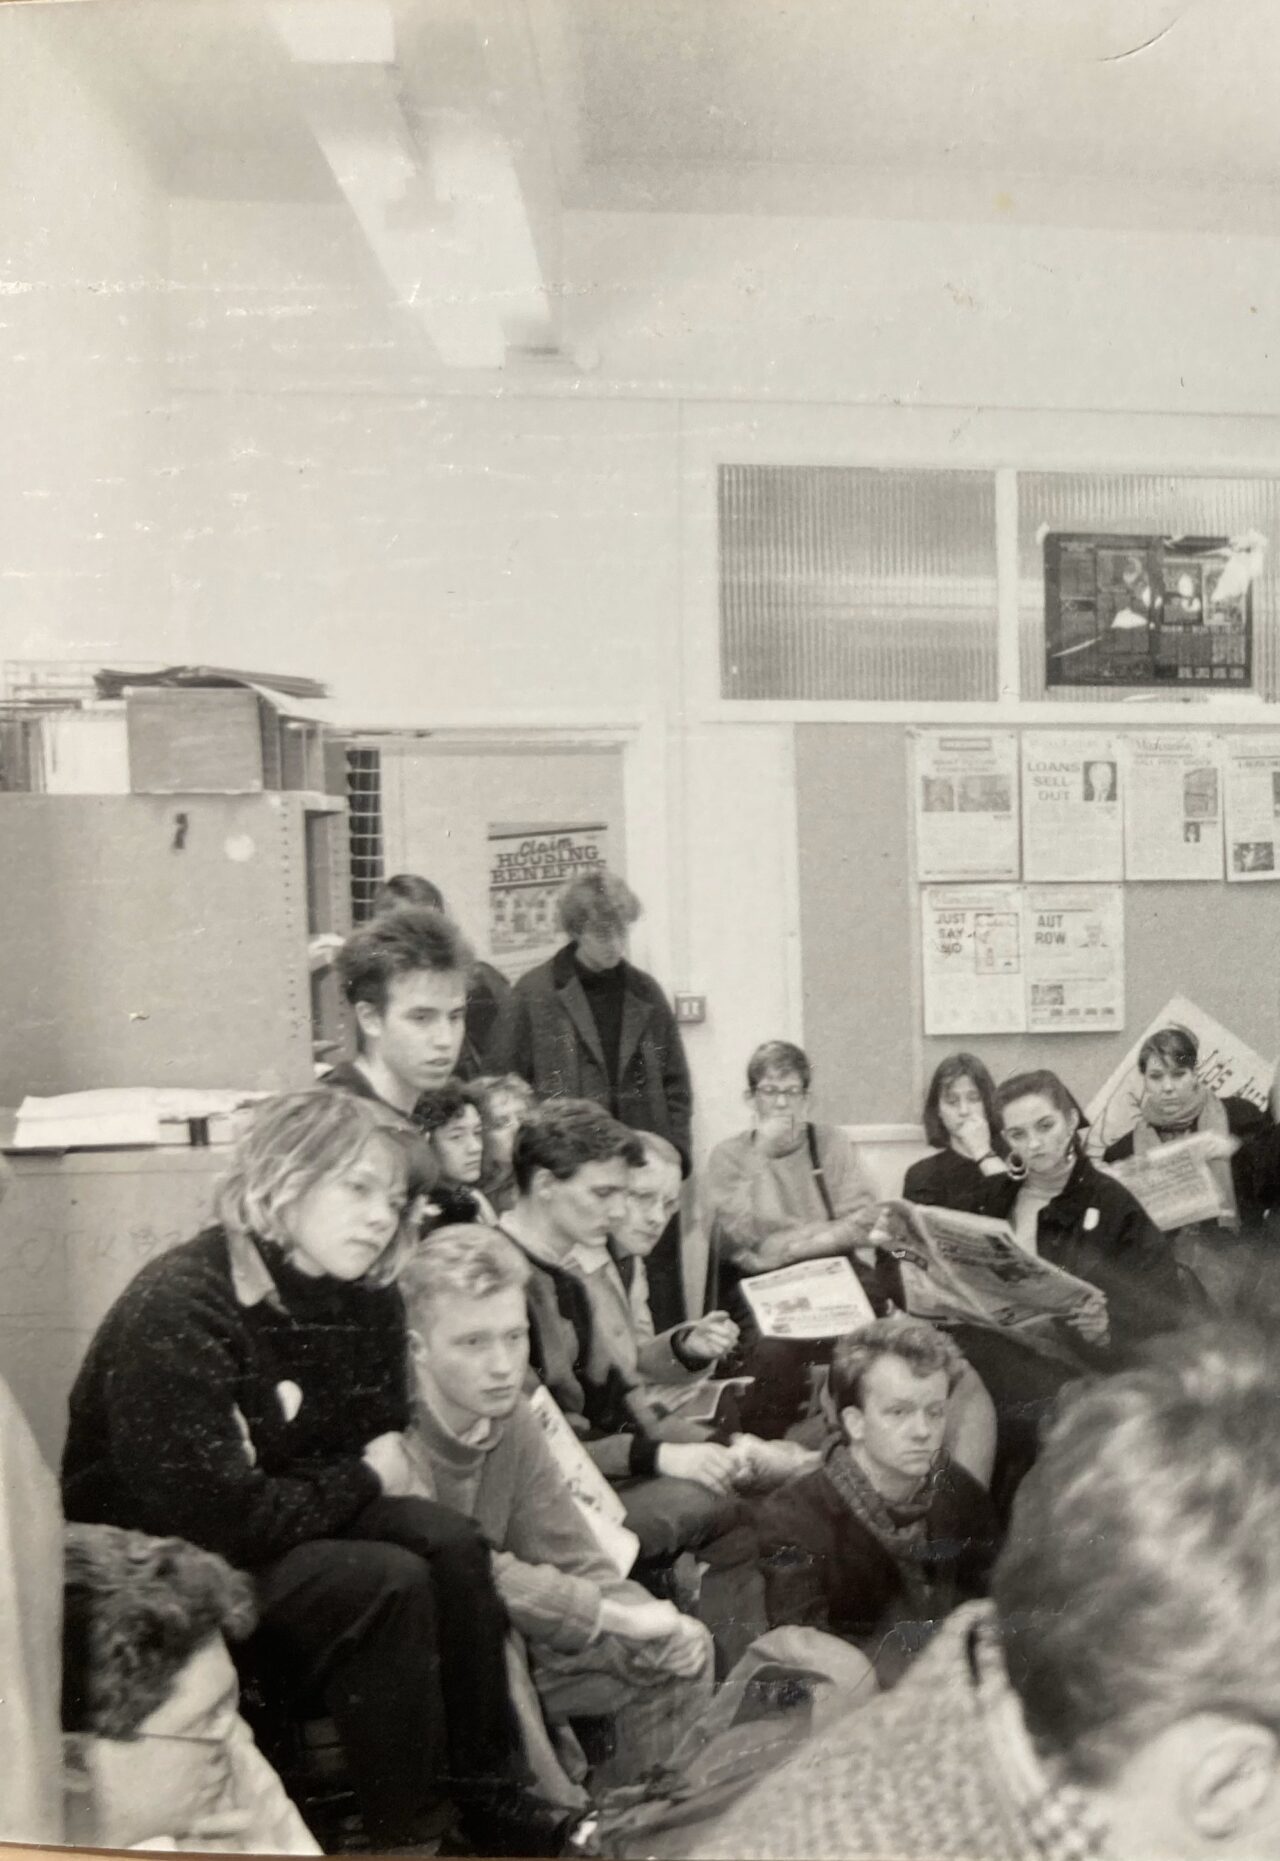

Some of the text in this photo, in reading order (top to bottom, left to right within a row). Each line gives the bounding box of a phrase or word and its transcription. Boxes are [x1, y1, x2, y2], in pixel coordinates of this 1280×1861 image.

[1027, 761, 1081, 773] LOANS
[1037, 791, 1071, 802] OUT
[519, 837, 573, 857] Claim
[497, 845, 599, 867] HOUSING
[936, 913, 967, 925] JUST
[1037, 914, 1064, 928] AUT
[938, 928, 965, 940] SAY
[1034, 931, 1066, 945] ROW
[940, 942, 963, 956] NO
